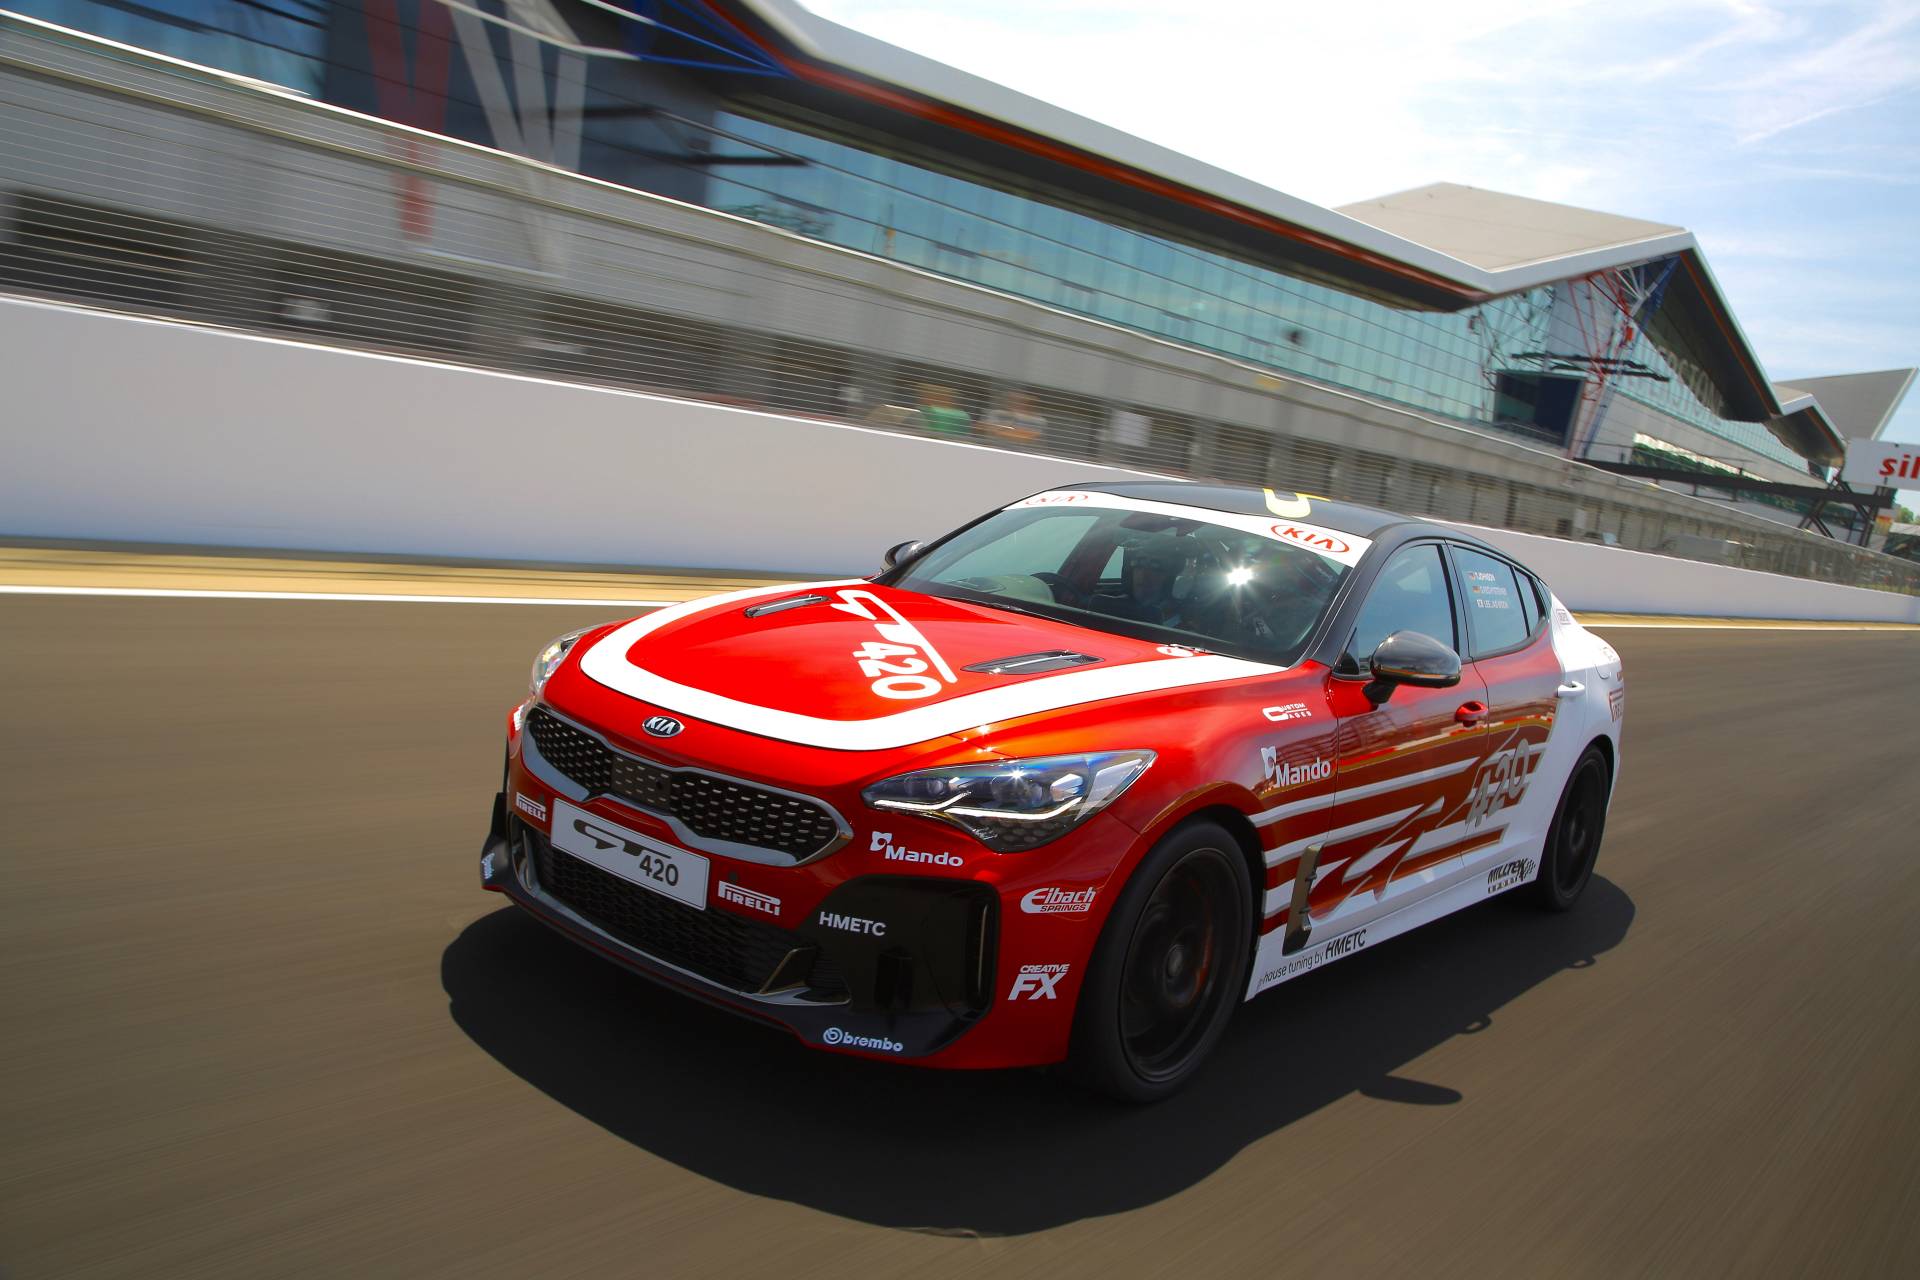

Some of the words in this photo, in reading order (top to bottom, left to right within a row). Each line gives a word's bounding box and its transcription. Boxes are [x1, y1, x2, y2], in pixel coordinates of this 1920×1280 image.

[1282, 527, 1334, 550] KIA
[853, 641, 942, 700] 420
[645, 716, 676, 735] KIA
[1273, 757, 1331, 788] Mando
[1464, 738, 1530, 828] 420
[516, 792, 546, 822] PIRELLI
[884, 844, 964, 867] Mando
[639, 855, 679, 887] 420
[718, 881, 781, 916] PIRELLI
[1021, 887, 1097, 913] Eibach
[1040, 904, 1087, 912] SPRINGS
[819, 911, 887, 936] HMETC
[1288, 957, 1313, 974] tuning
[1315, 951, 1324, 965] by
[1325, 929, 1367, 959] HMETC
[1020, 964, 1070, 973] CREATIVE
[1008, 973, 1066, 1000] FX
[842, 1032, 904, 1052] brembo
